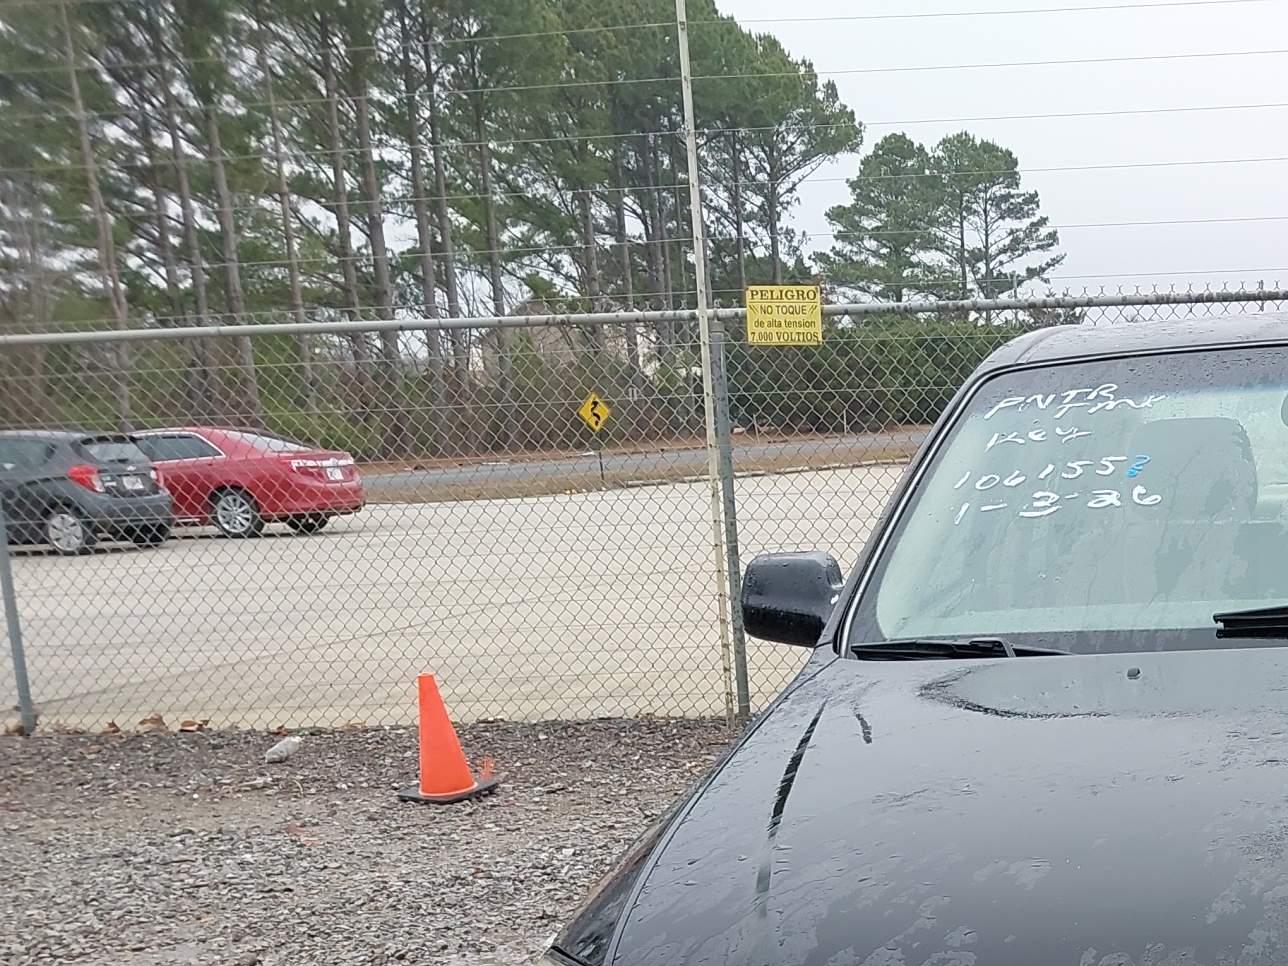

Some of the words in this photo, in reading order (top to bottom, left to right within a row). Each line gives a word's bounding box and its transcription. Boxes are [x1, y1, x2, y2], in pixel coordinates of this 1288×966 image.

[750, 289, 816, 300] PELIGRO
[760, 305, 773, 315] NO
[775, 305, 807, 316] TOQUE
[754, 319, 765, 328] de
[766, 319, 782, 328] alta
[784, 319, 816, 328] tension
[775, 331, 819, 342] VOLTIOS
